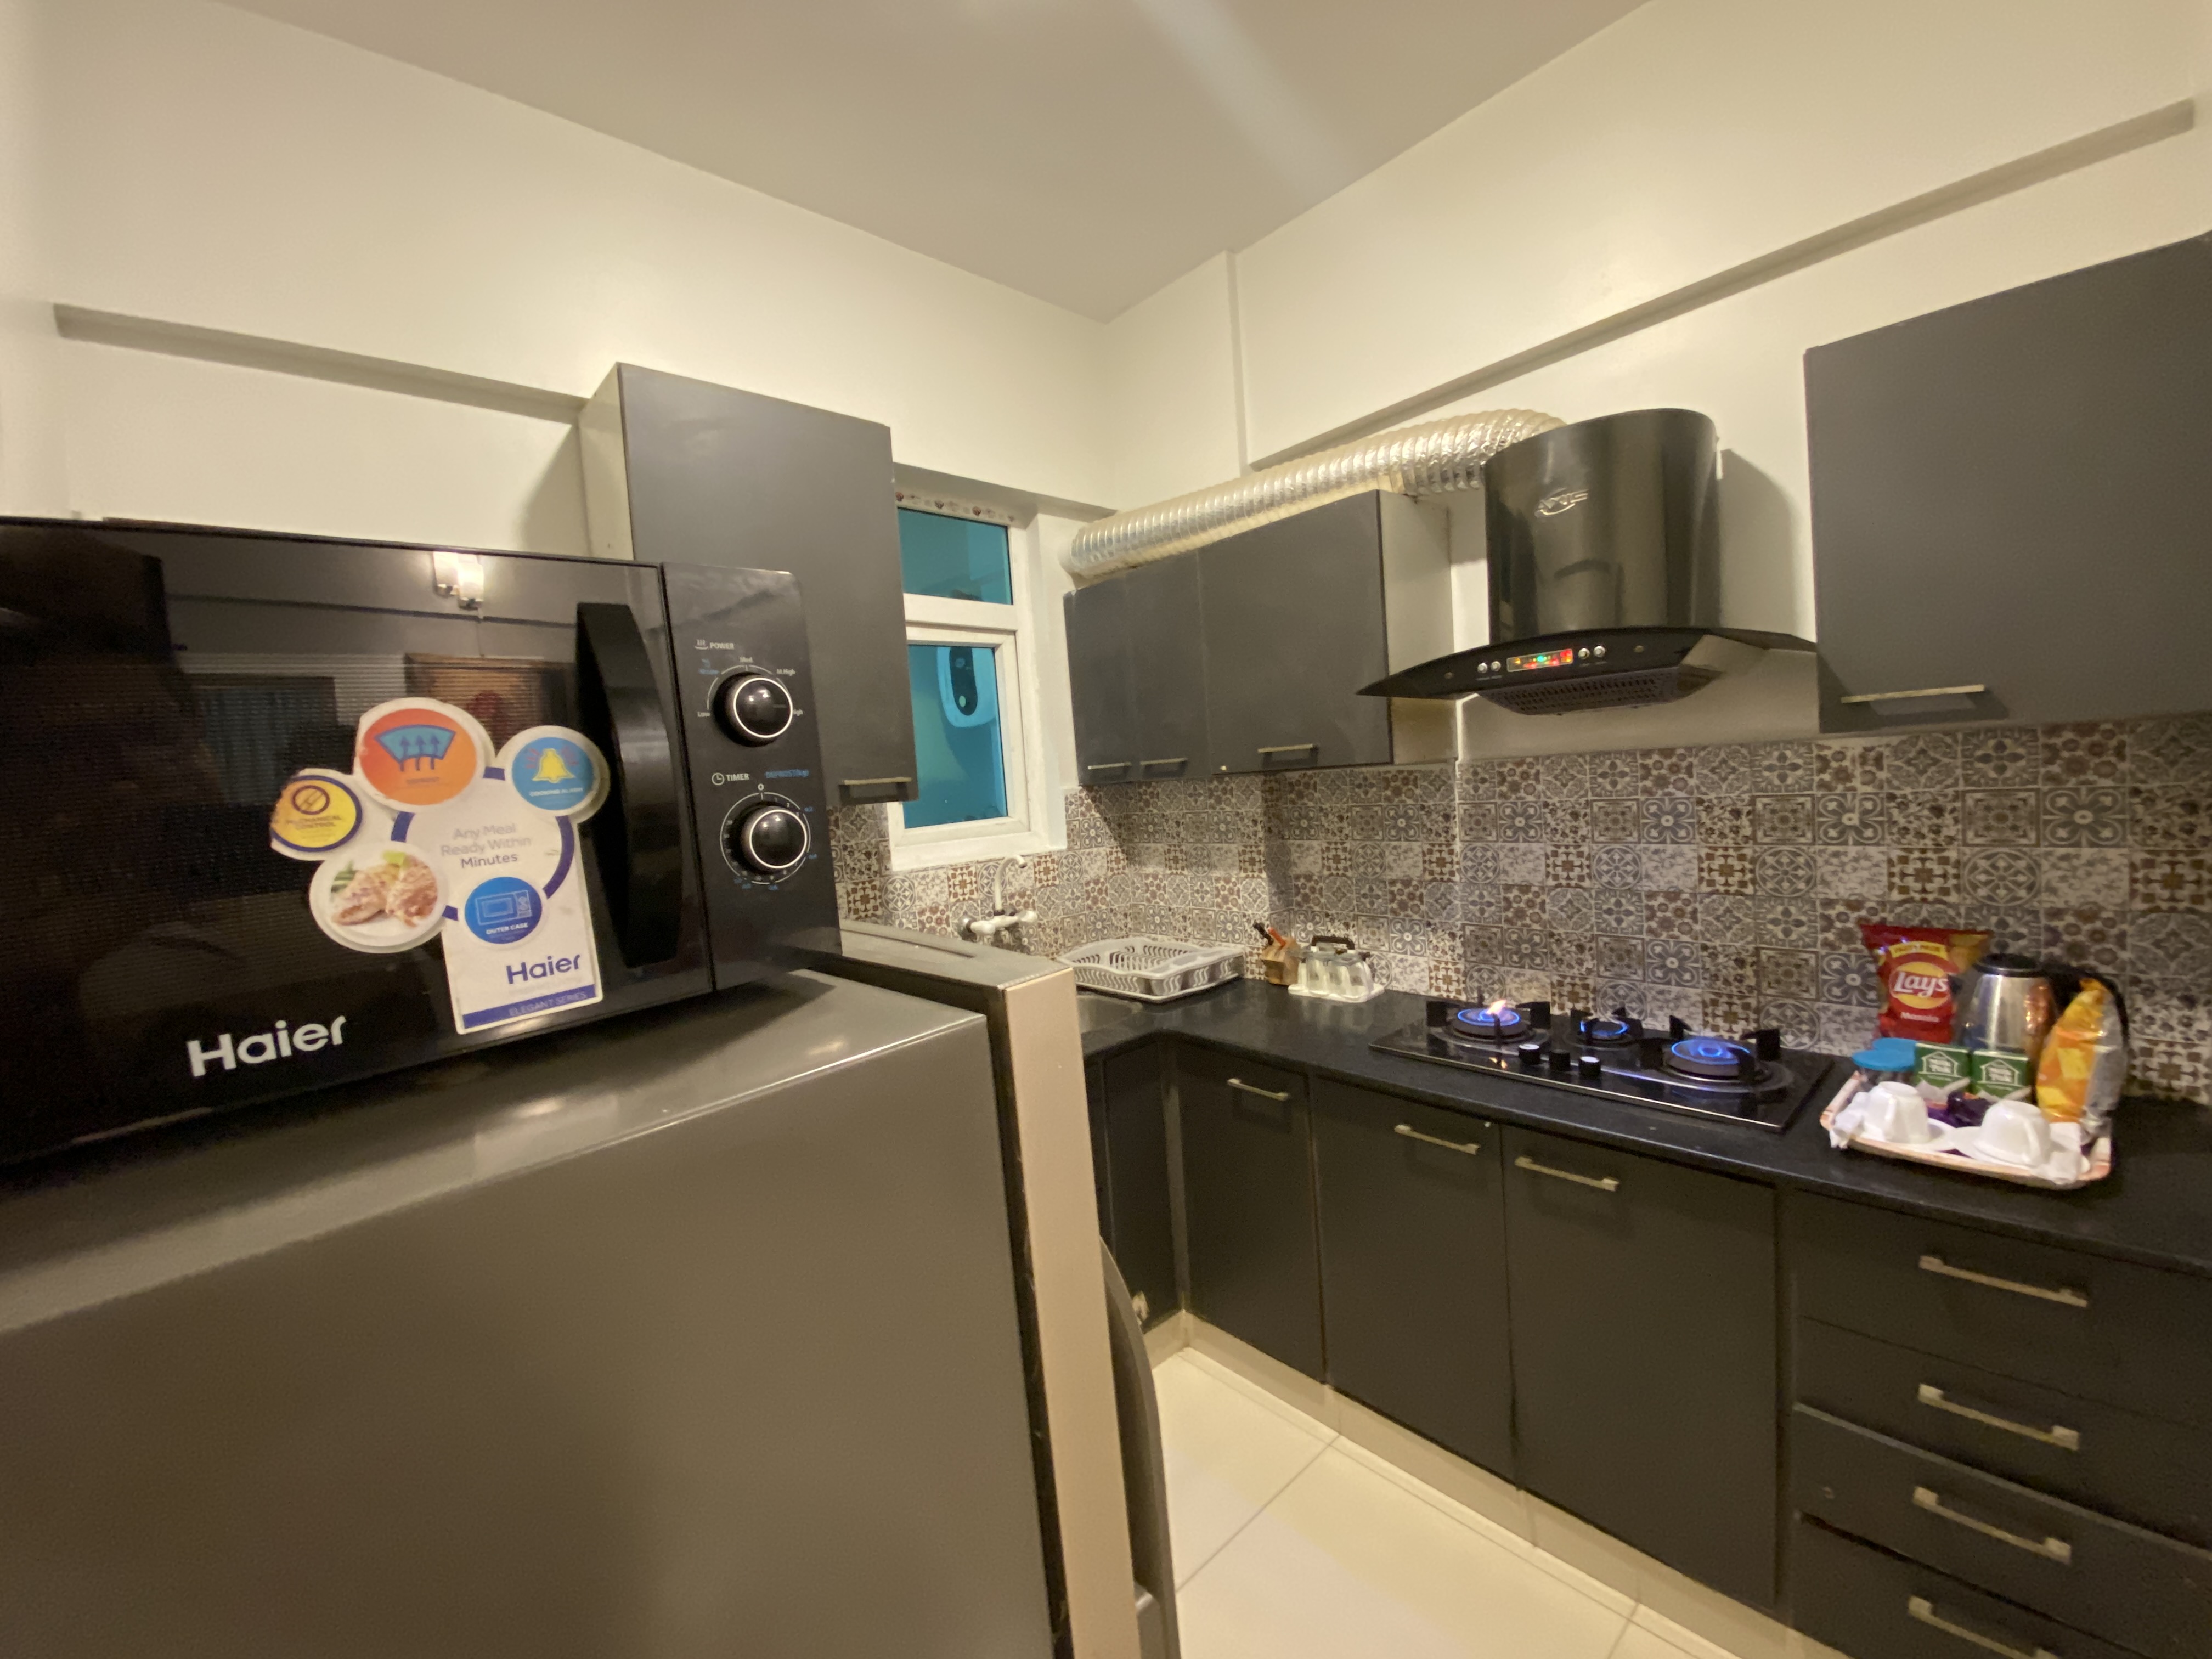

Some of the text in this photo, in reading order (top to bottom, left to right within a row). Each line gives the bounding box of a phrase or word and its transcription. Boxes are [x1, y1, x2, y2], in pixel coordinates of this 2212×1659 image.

[726, 773, 749, 781] TIMER
[452, 823, 516, 840] Any Meal
[441, 838, 532, 856] Ready Within
[461, 854, 518, 868] Minutes
[486, 922, 528, 935] OUTER CASE
[506, 955, 580, 985] Haier
[509, 991, 588, 1017] ELEGANT SERIES
[187, 1015, 347, 1077] Haier
